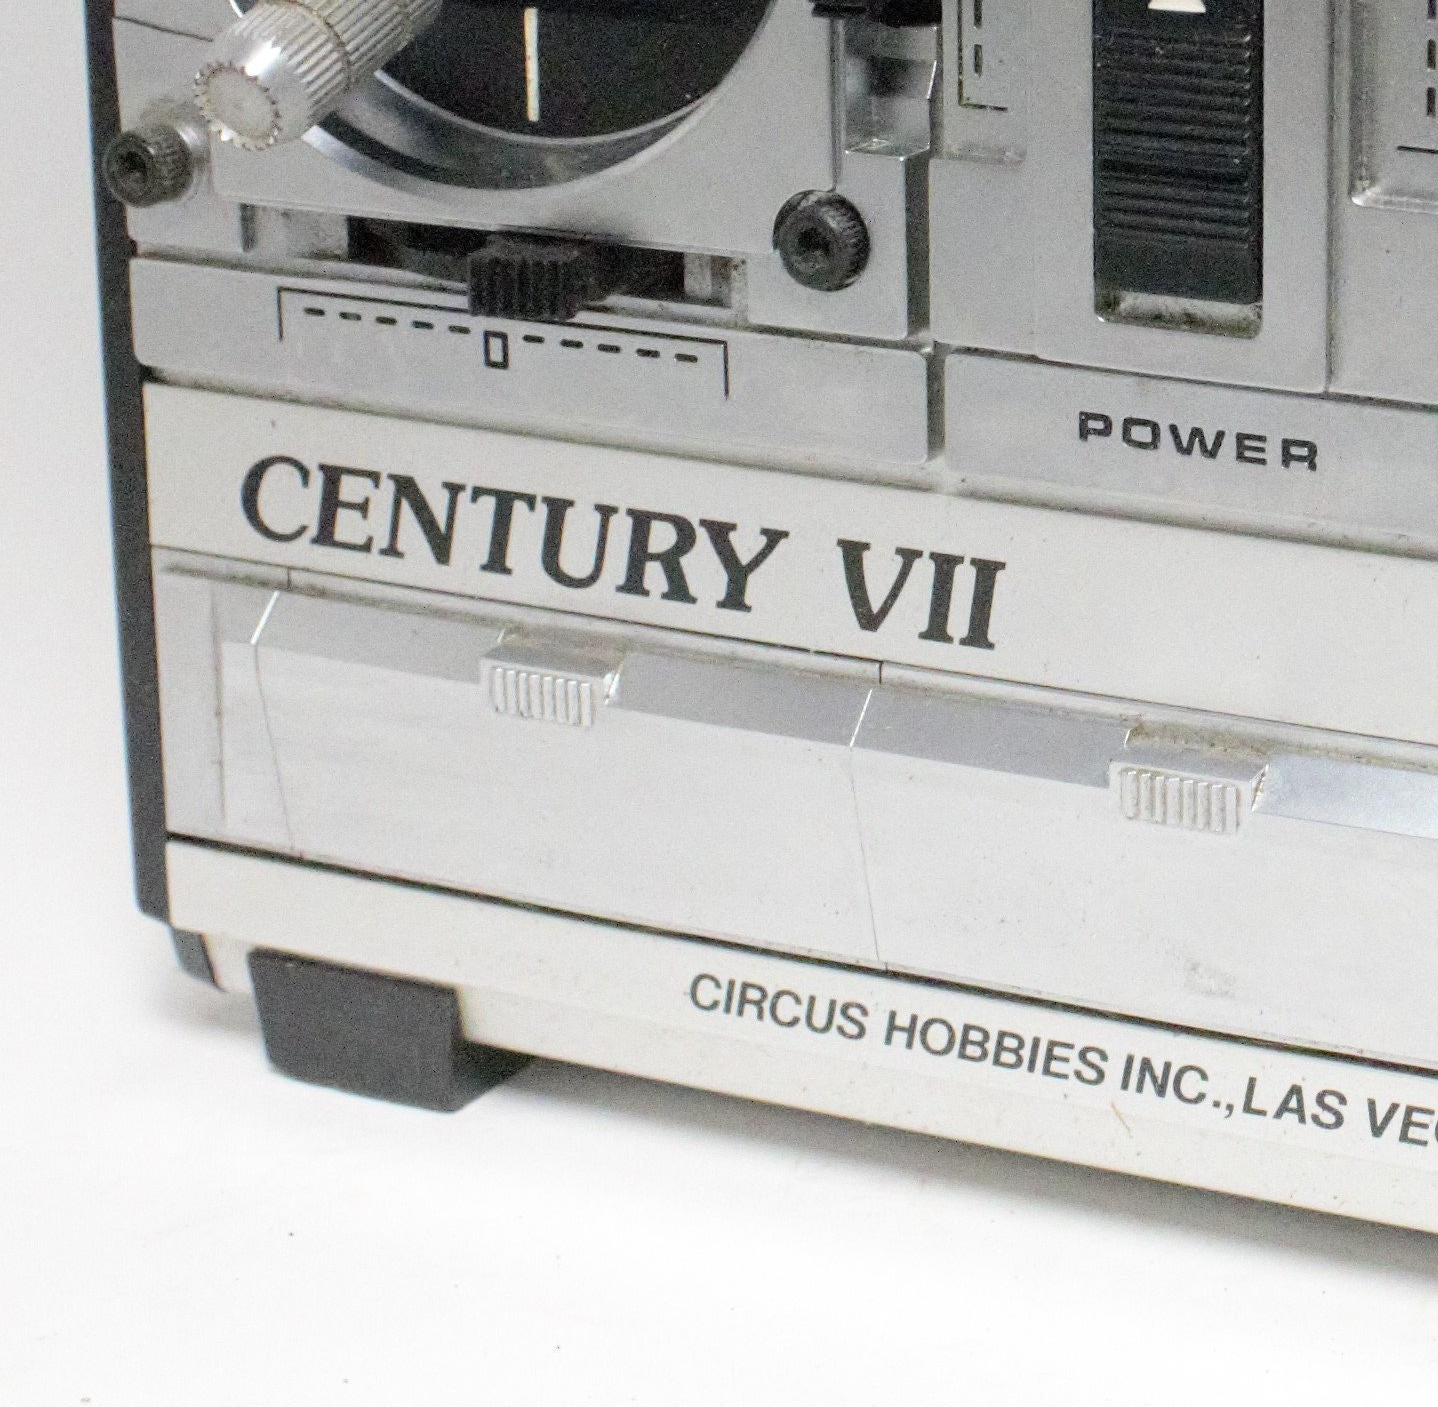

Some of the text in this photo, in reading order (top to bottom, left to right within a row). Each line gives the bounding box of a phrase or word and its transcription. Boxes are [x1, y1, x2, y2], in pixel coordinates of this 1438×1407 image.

[1078, 411, 1318, 472] POWER
[240, 455, 1007, 651] CENTURY VII
[689, 973, 869, 1041] CIRCUS
[883, 1009, 1109, 1086] HOBBIES
